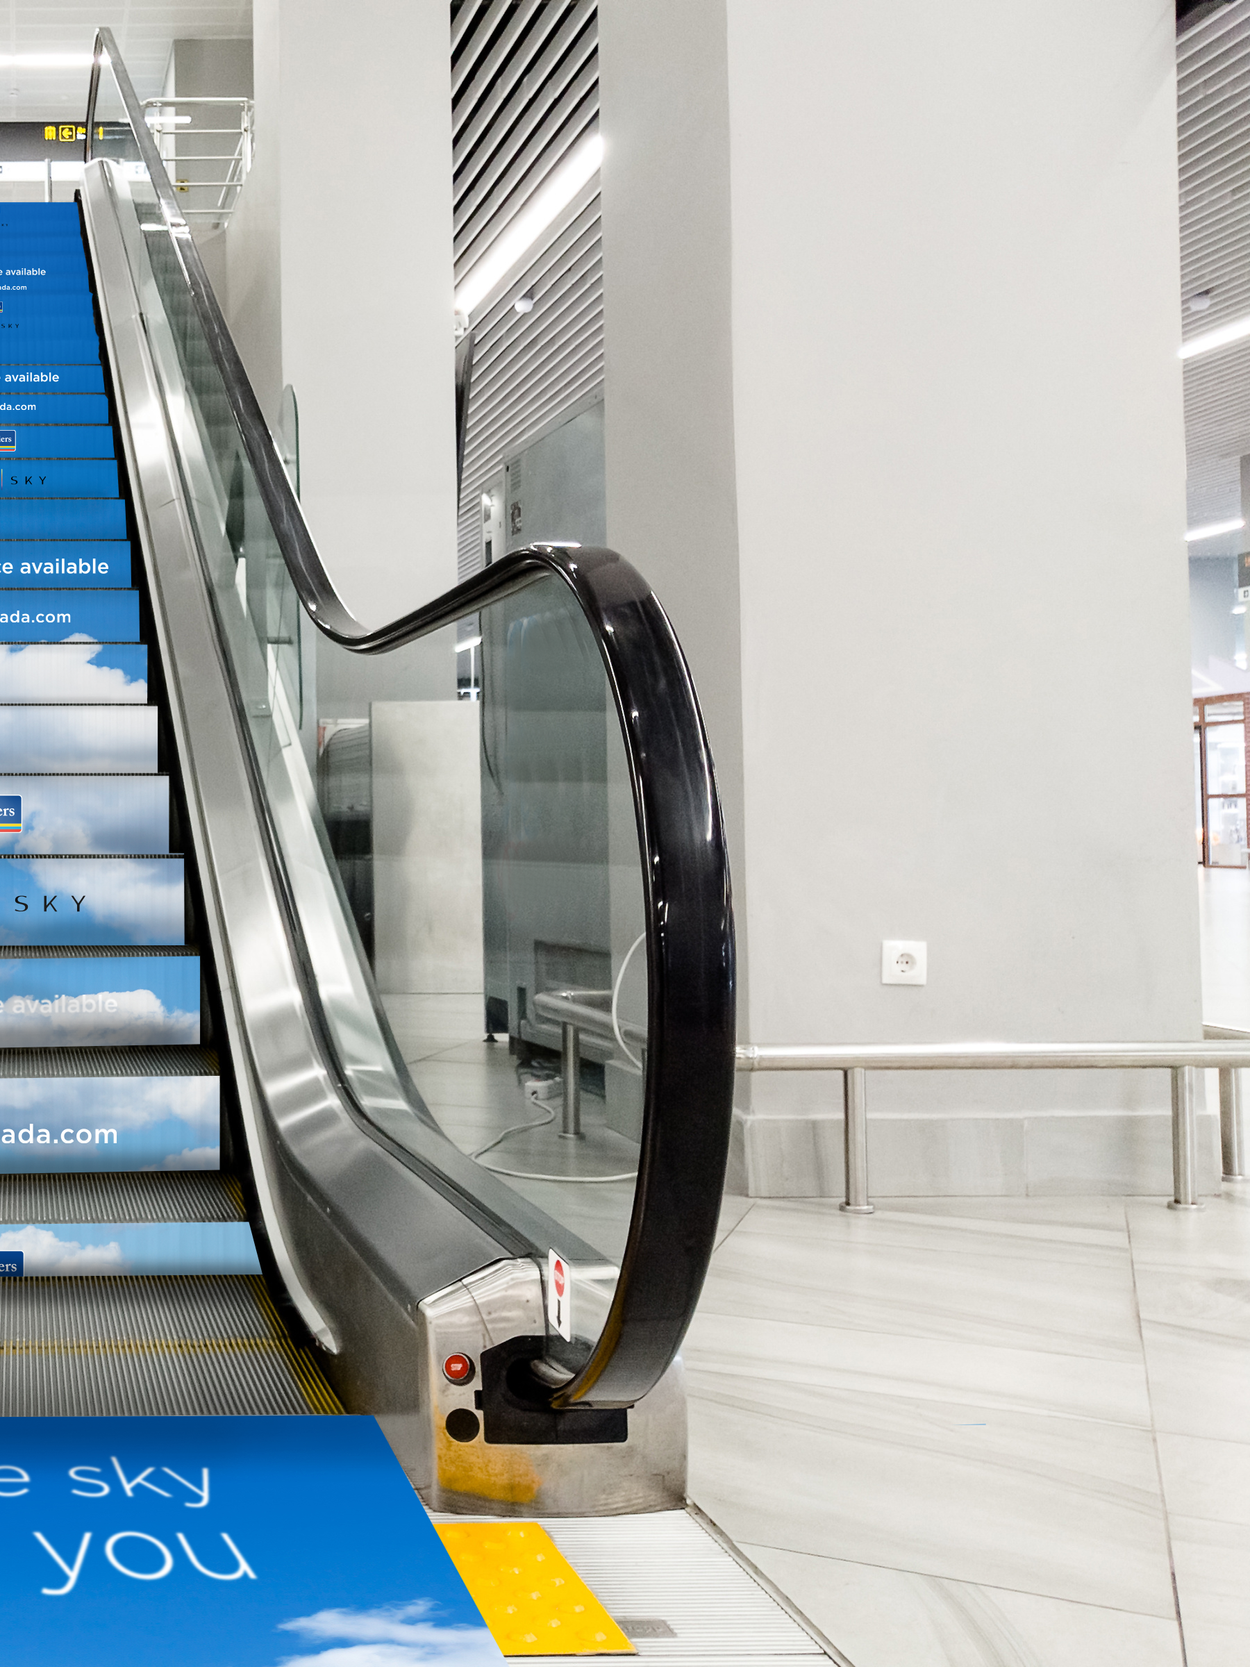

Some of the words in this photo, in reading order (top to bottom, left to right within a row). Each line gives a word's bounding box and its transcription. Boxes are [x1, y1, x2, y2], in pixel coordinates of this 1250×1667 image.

[5, 268, 46, 276] available
[5, 372, 59, 383] available
[10, 475, 47, 485] SKY
[20, 558, 109, 575] available
[14, 896, 86, 912] SKY
[12, 994, 118, 1015] available
[68, 1456, 210, 1508] sky
[33, 1531, 258, 1596] you
